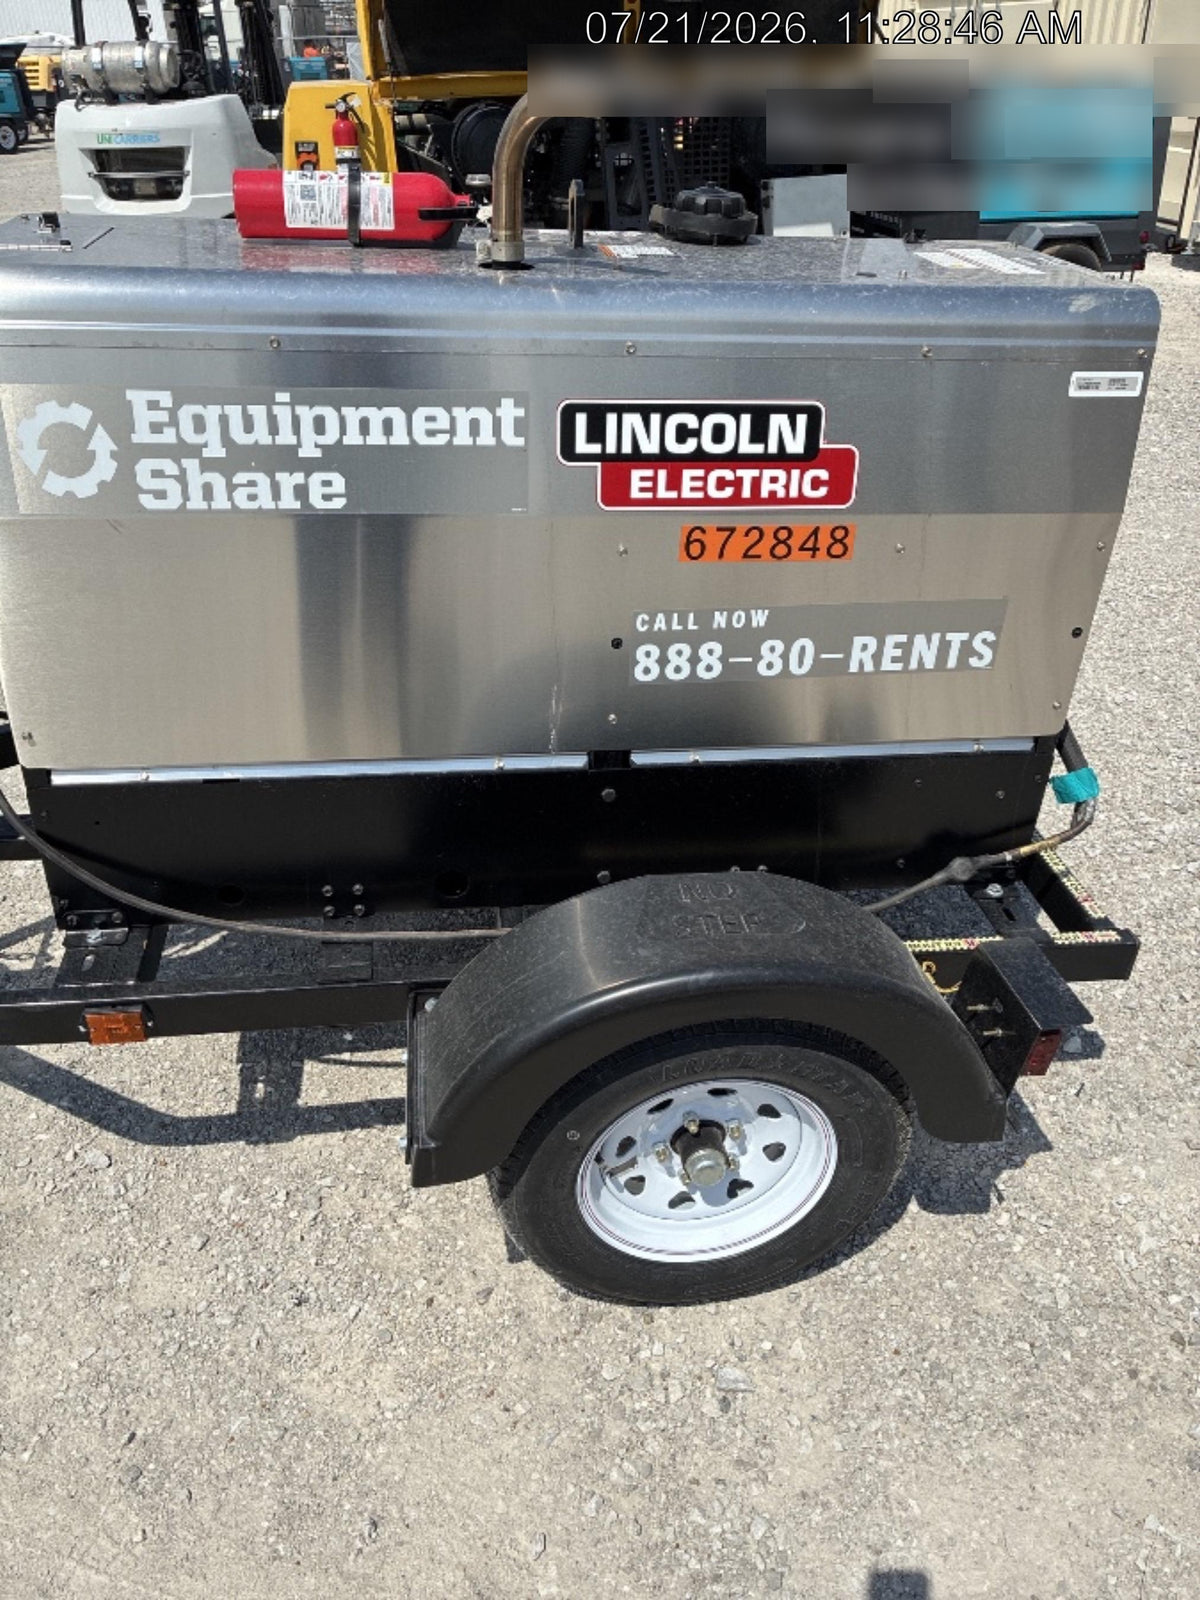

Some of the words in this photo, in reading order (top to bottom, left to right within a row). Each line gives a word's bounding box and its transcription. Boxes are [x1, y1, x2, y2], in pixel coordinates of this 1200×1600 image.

[126, 389, 525, 458] Equipment
[574, 411, 808, 455] LINCOLN
[134, 458, 348, 510] Share
[630, 468, 829, 500] ELECTRIC
[684, 525, 851, 561] 672848
[636, 614, 699, 632] CALL
[712, 608, 769, 630] NOW
[633, 629, 997, 683] 888-80-RENTS
